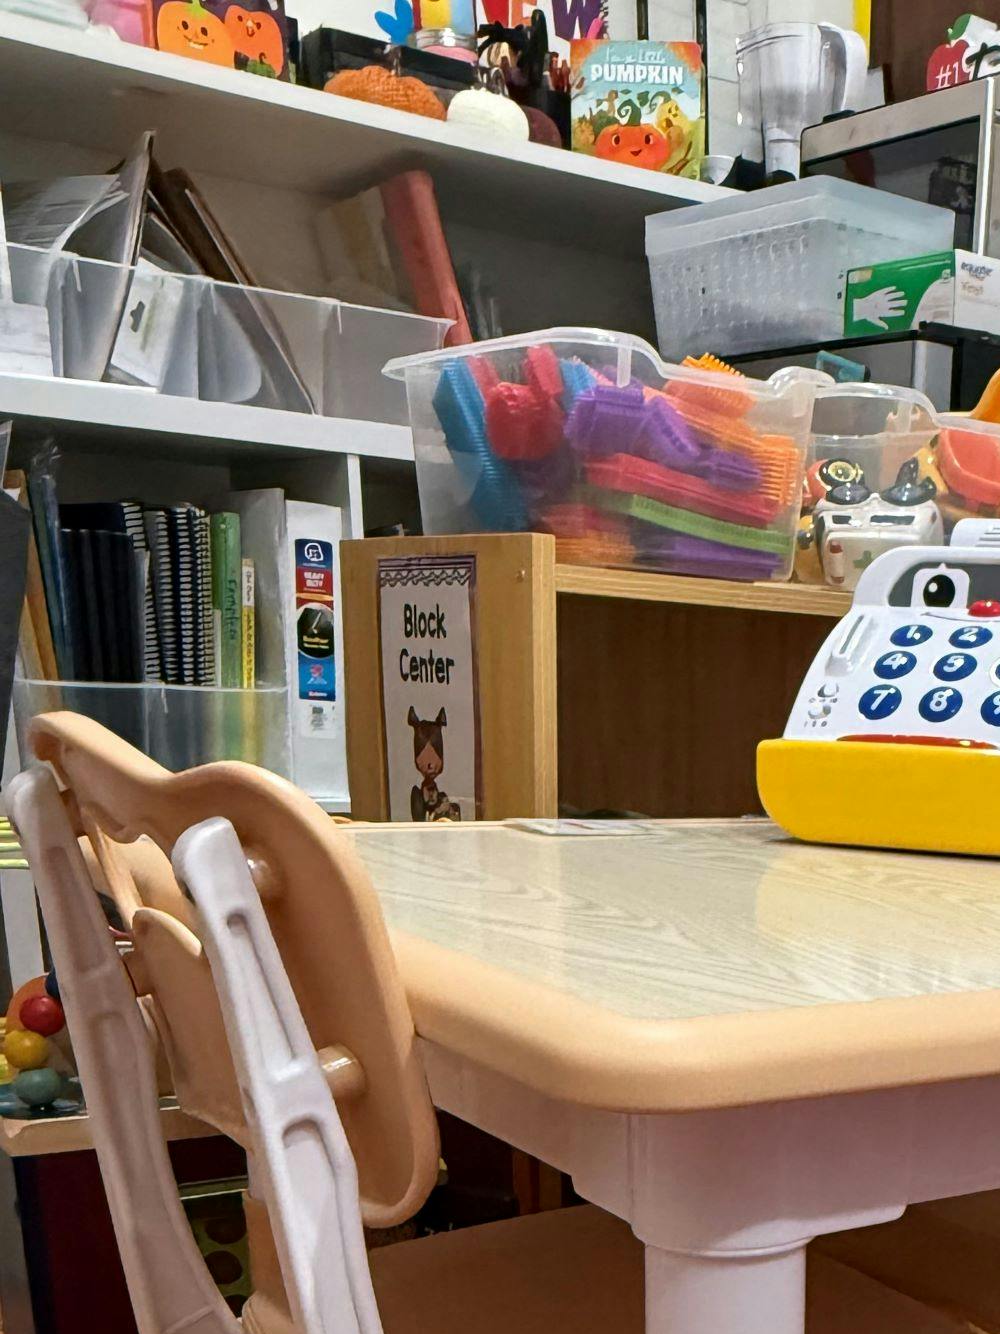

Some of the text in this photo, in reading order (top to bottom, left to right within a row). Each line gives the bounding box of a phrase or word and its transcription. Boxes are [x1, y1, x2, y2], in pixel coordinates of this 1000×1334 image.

[590, 63, 684, 85] PUMPKIN
[403, 602, 448, 640] Block
[959, 627, 978, 639] 2
[399, 647, 456, 686] Center
[882, 652, 908, 669] 4
[943, 655, 965, 673] 5
[870, 687, 897, 712] 7
[928, 688, 954, 713] 8
